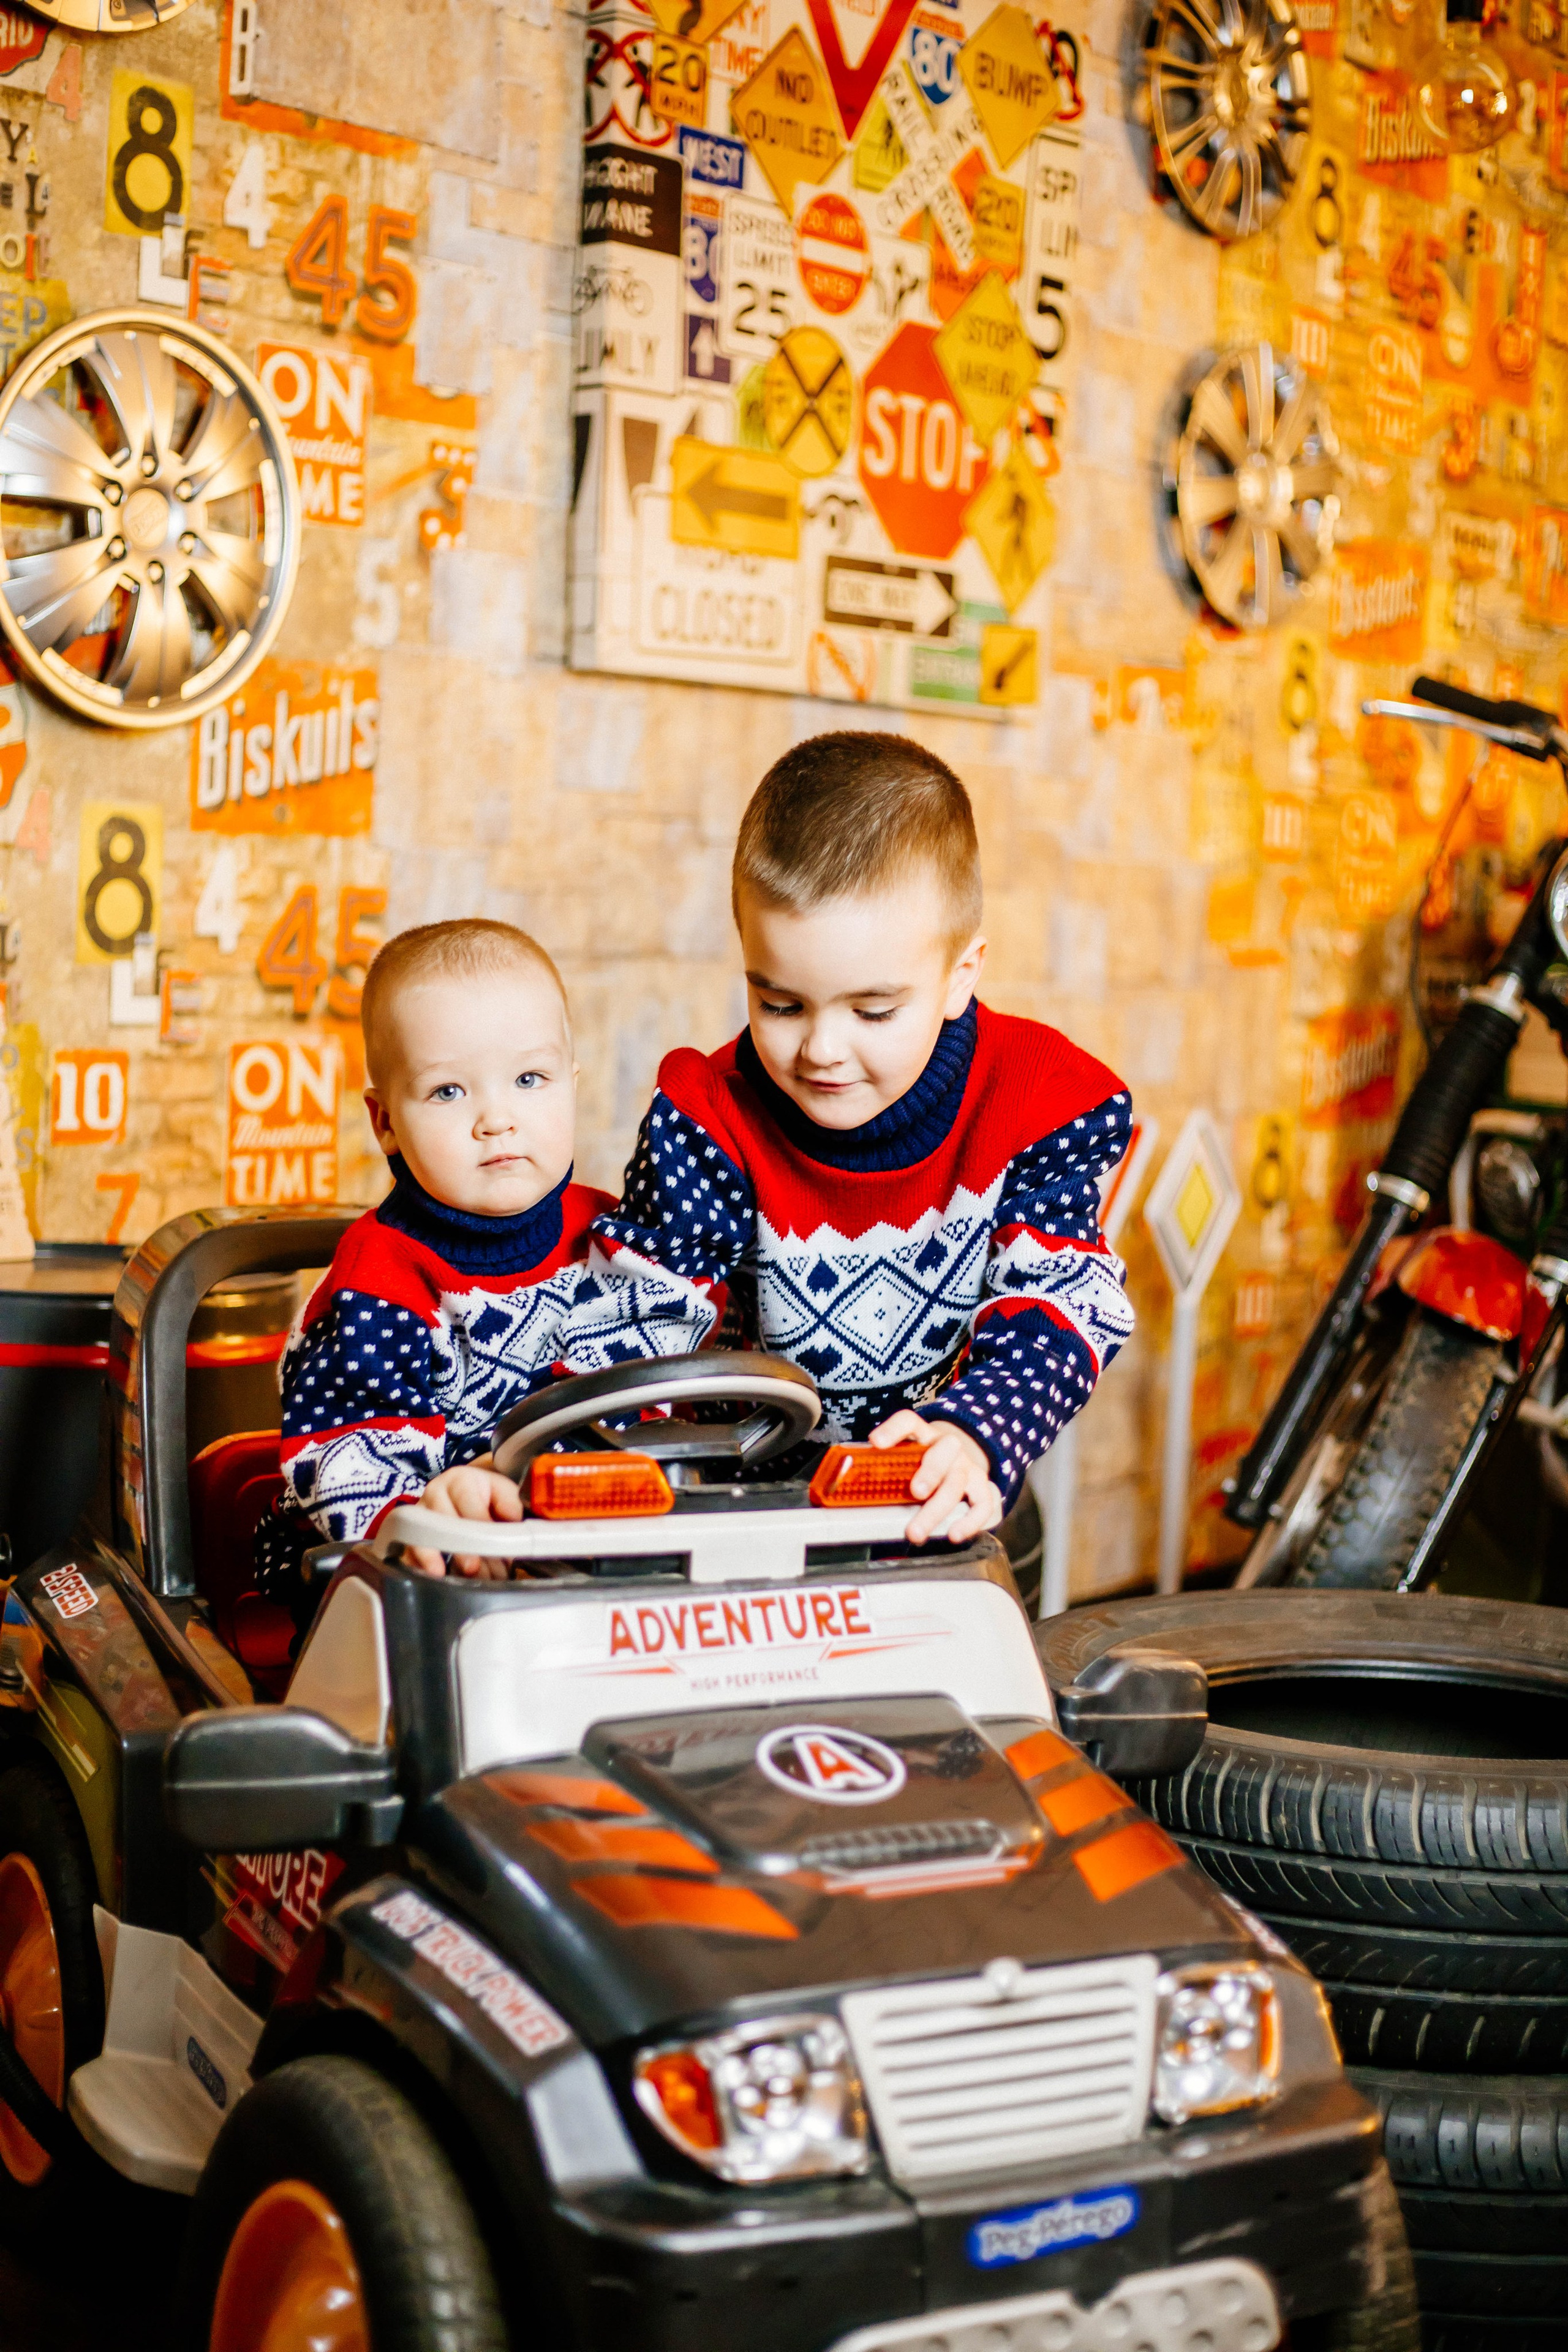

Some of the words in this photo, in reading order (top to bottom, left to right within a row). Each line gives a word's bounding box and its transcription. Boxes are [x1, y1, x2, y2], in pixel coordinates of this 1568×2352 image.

[46, 44, 82, 123] 4
[657, 44, 701, 93] 20
[775, 67, 813, 104] NO
[914, 29, 960, 93] 80
[975, 51, 1049, 107] BUMP
[1, 119, 29, 162] Y
[112, 86, 183, 231] 8
[684, 136, 742, 185] WEST
[224, 146, 270, 248] 4
[138, 235, 188, 309] L
[285, 195, 418, 340] 45
[734, 282, 792, 341] 25
[1035, 276, 1066, 360] 5
[260, 350, 366, 440] ON
[300, 462, 363, 522] ME
[650, 583, 784, 650] CLOSED
[197, 677, 381, 811] Biskuits
[85, 816, 153, 956] 8
[195, 848, 243, 954] 4
[257, 885, 388, 1019] 45
[55, 1061, 124, 1132] 10
[232, 1043, 337, 1118] ON
[95, 1173, 140, 1244] 7
[230, 1152, 336, 1205] TIME
[45, 1572, 99, 1619] SPEED
[610, 1589, 872, 1657] ADVENTURE
[690, 1674, 720, 1692] HIGH
[725, 1665, 820, 1689] PERFORMANCE
[795, 1735, 883, 1790] A
[467, 1968, 573, 2057] POWER
